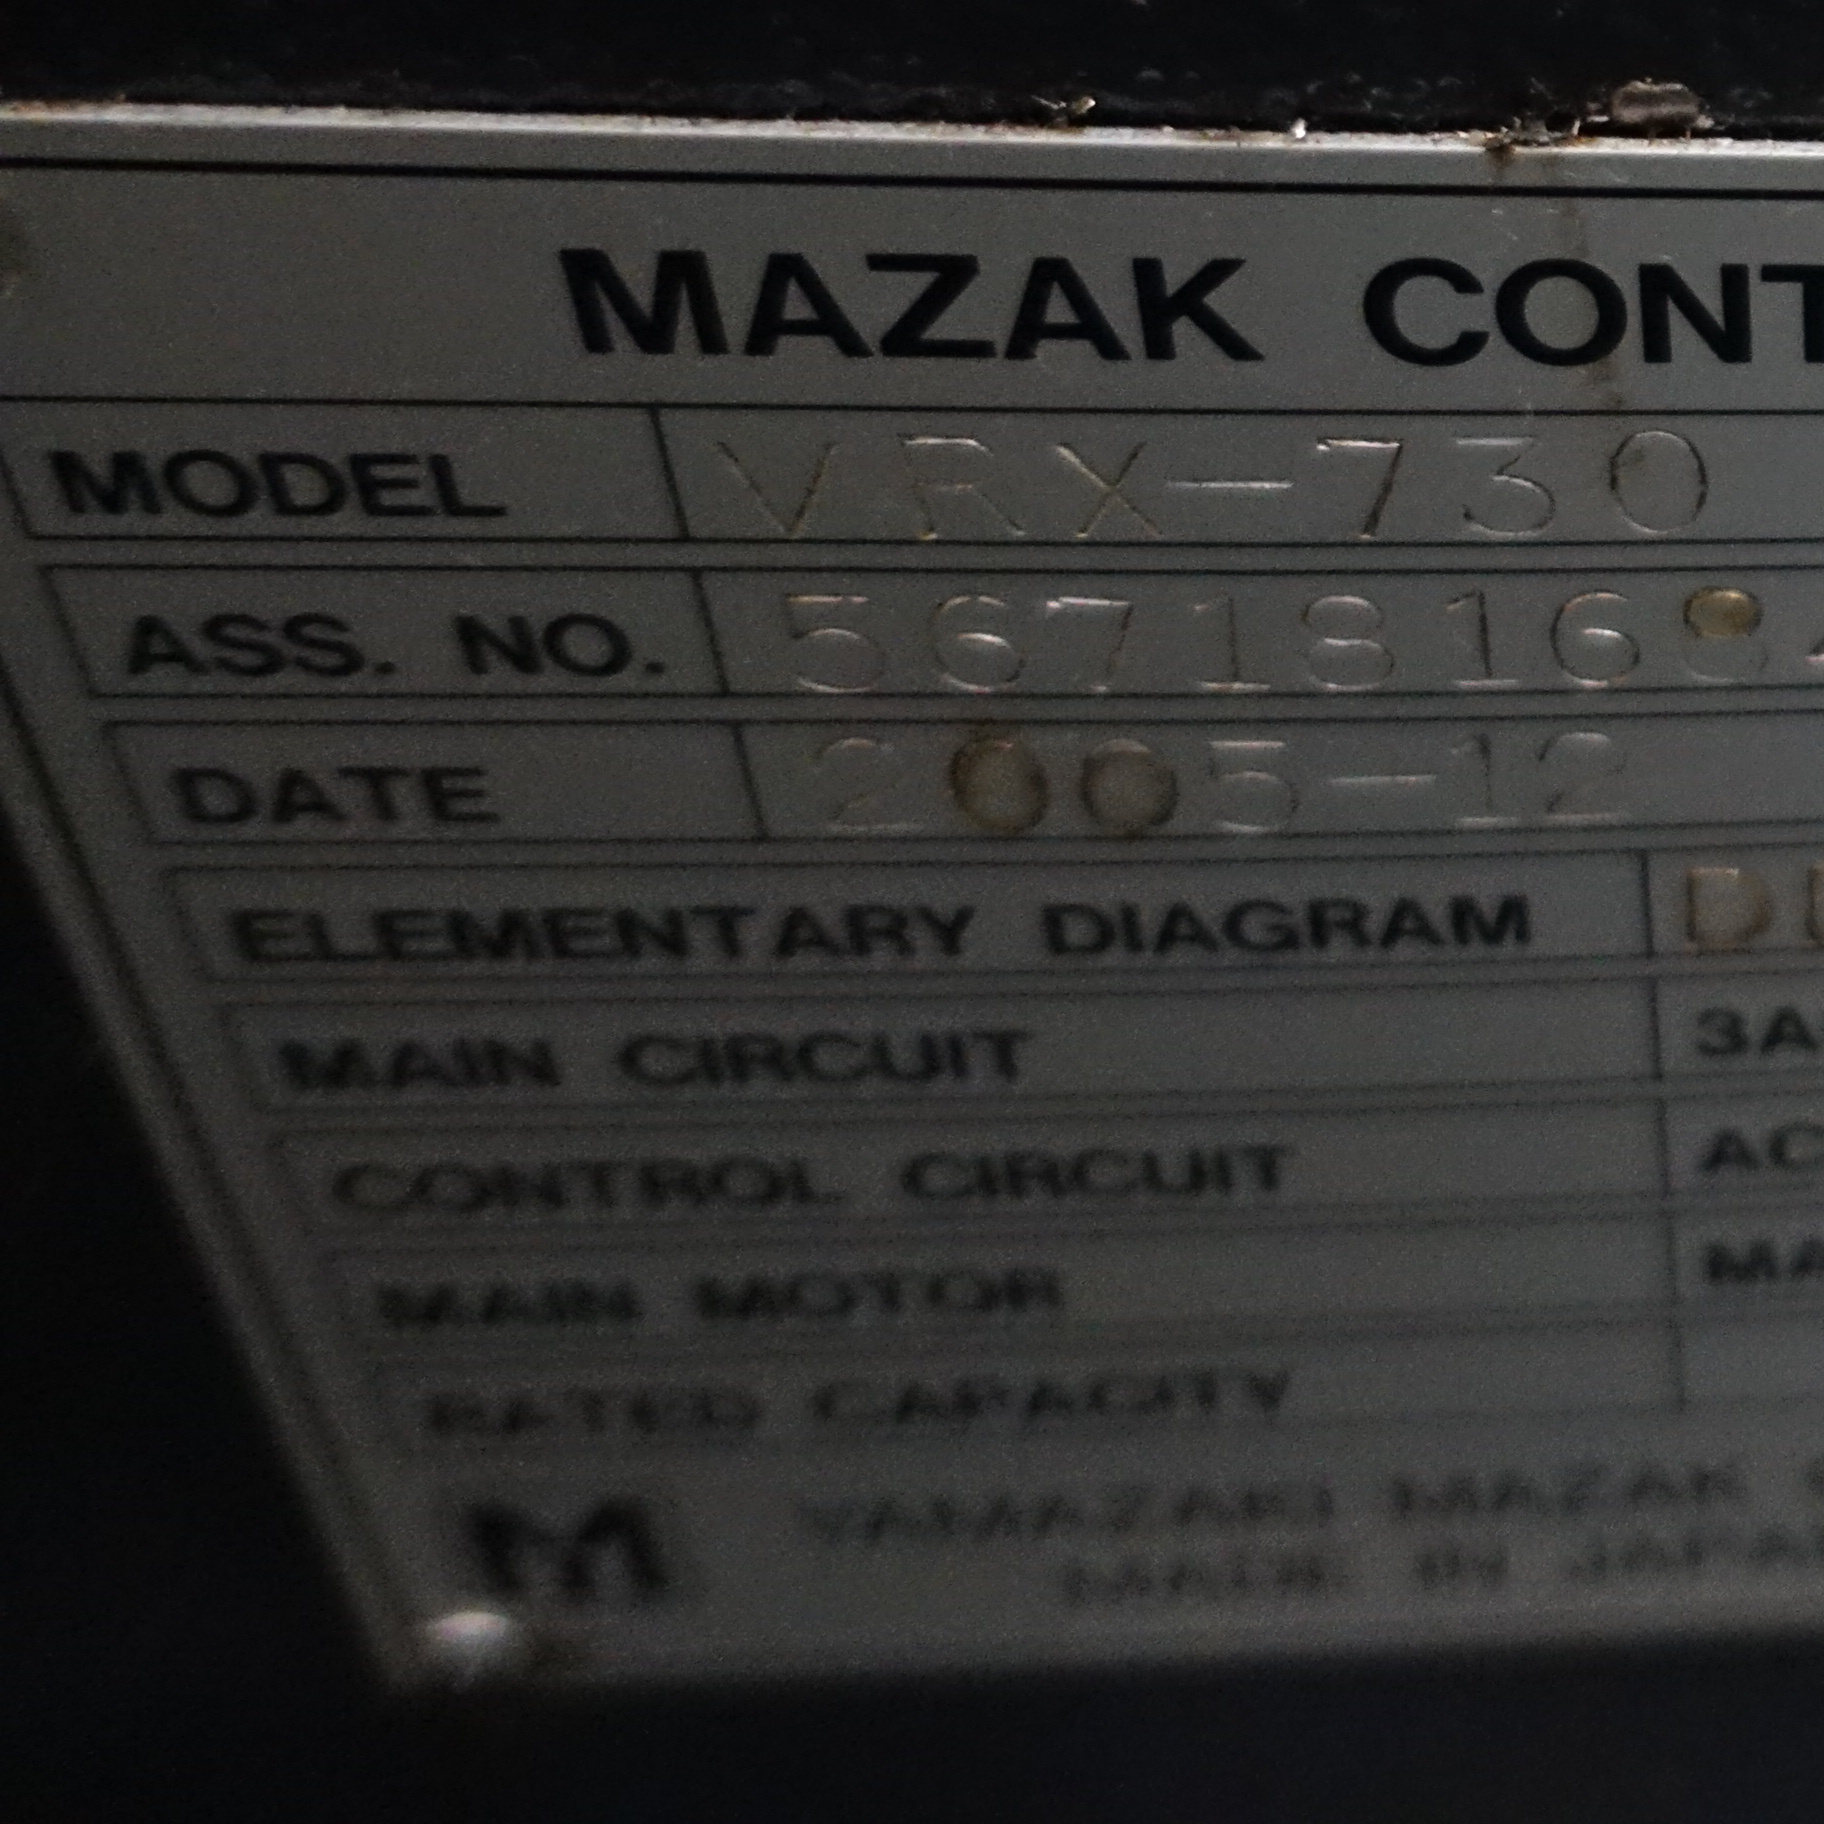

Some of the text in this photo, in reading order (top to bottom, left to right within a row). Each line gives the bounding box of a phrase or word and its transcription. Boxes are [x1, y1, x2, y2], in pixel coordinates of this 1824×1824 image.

[558, 248, 1263, 362] MAZAK
[48, 426, 1710, 541] MODEL VRX-730
[126, 614, 393, 679] ASS.
[457, 614, 664, 679] NO.
[174, 727, 1633, 836] DATE 2005-12
[229, 903, 975, 966] ELEMENTARY
[1041, 894, 1532, 958] DIAGRAM
[278, 1036, 563, 1090] MAIN
[615, 1028, 1035, 1088] CIRCUIT
[328, 1153, 842, 1213] CONTROL
[896, 1143, 1297, 1204] CIRCUIT
[375, 1281, 641, 1326] MAIN
[693, 1266, 1065, 1319] MOTOR
[420, 1389, 765, 1438] RATED
[810, 1369, 1292, 1428] CAPACITY
